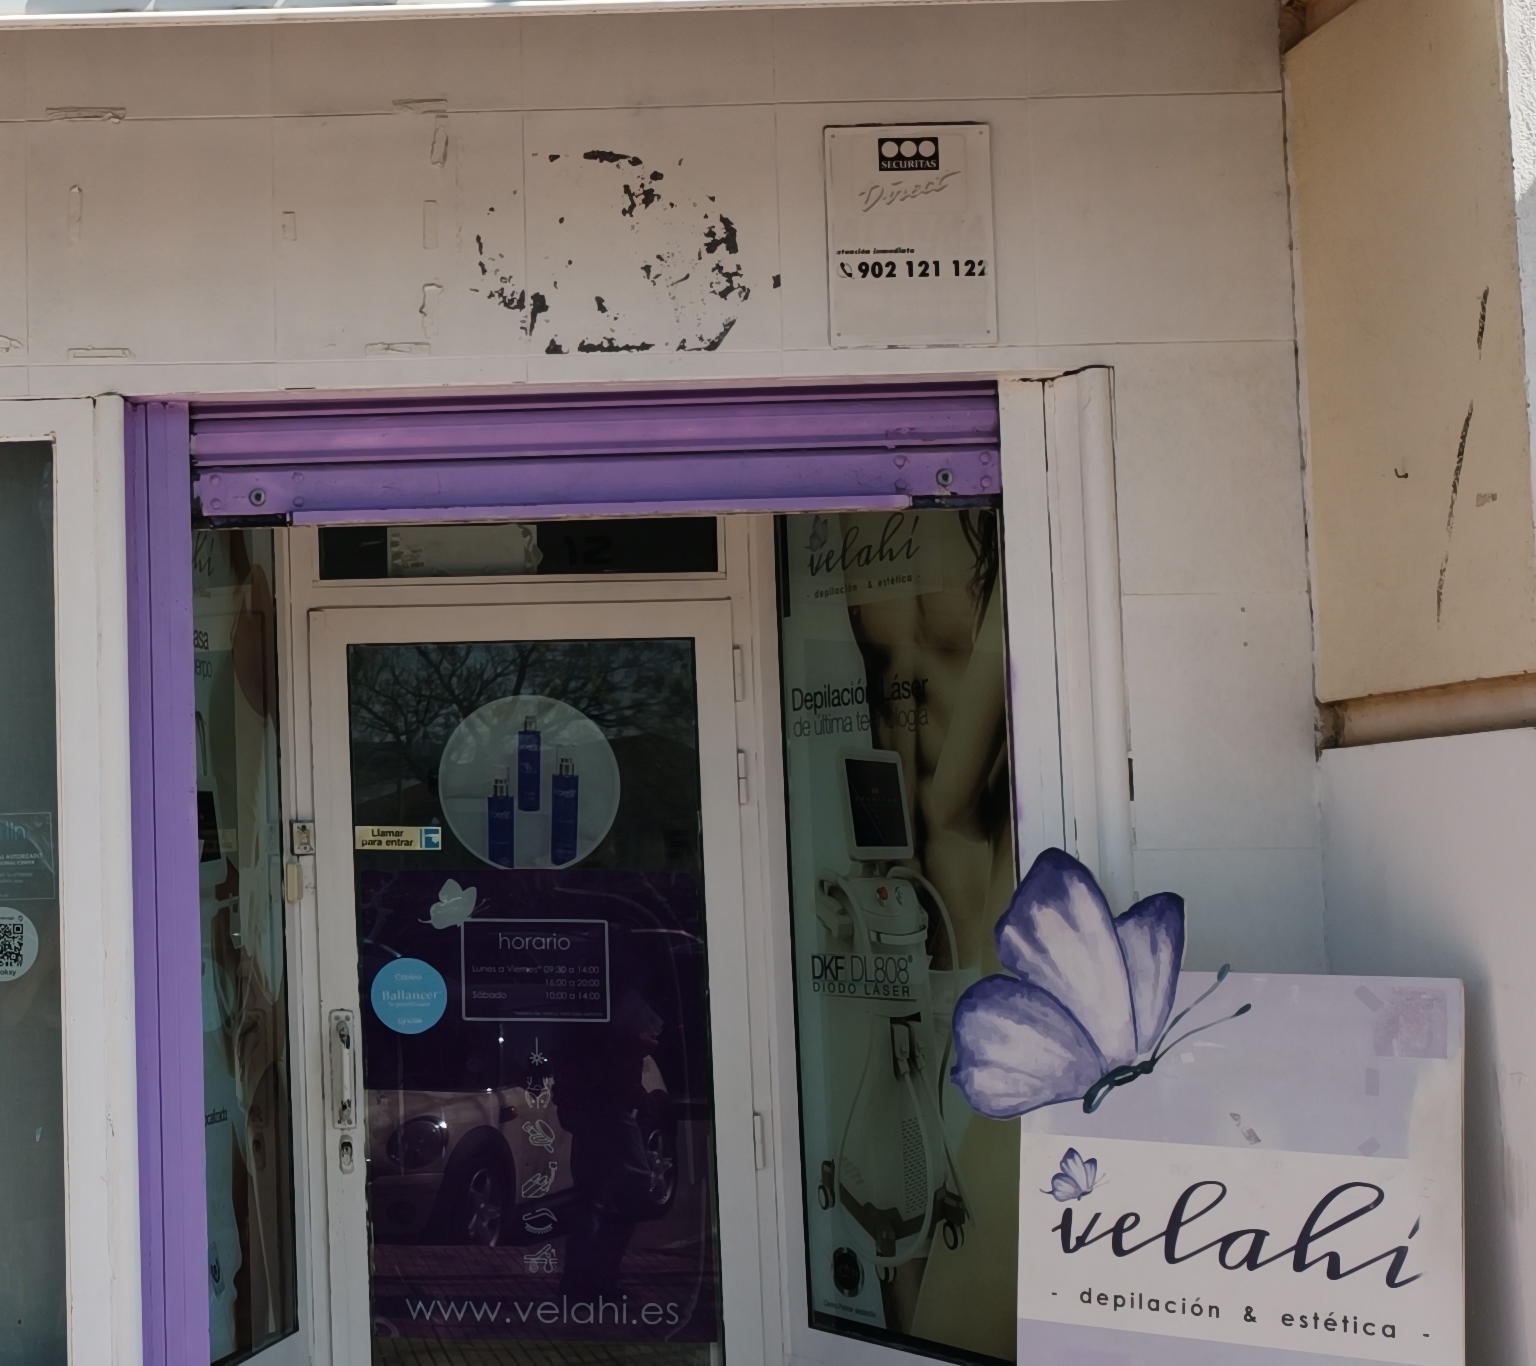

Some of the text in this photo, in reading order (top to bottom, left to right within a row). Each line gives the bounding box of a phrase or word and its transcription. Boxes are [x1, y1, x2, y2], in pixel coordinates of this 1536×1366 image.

[881, 159, 937, 169] SECURITAS
[857, 261, 897, 279] 902
[905, 260, 940, 278] 121
[807, 511, 921, 577] velahi
[814, 582, 858, 600] depilación
[877, 573, 913, 589] estética
[882, 673, 929, 702] Láser
[793, 704, 929, 738] de última teologa
[361, 837, 414, 848] para entrar
[371, 828, 404, 838] Llamar
[498, 932, 571, 952] horario
[472, 964, 497, 974] Lunes
[498, 966, 505, 974] a
[543, 965, 567, 975] 09:30
[569, 967, 575, 975] a
[577, 965, 600, 975] 14:00
[811, 955, 845, 981] DKF
[545, 978, 600, 988] 16:00 a 20:00
[812, 981, 857, 995] DIODO
[472, 989, 508, 1000] Sábado
[545, 991, 567, 1000] 10:00
[577, 991, 601, 1001] 14:00
[1051, 1180, 1428, 1289] velahi
[405, 1295, 680, 1325] www.velahi.es
[1080, 1286, 1397, 1339] depilación & estética
